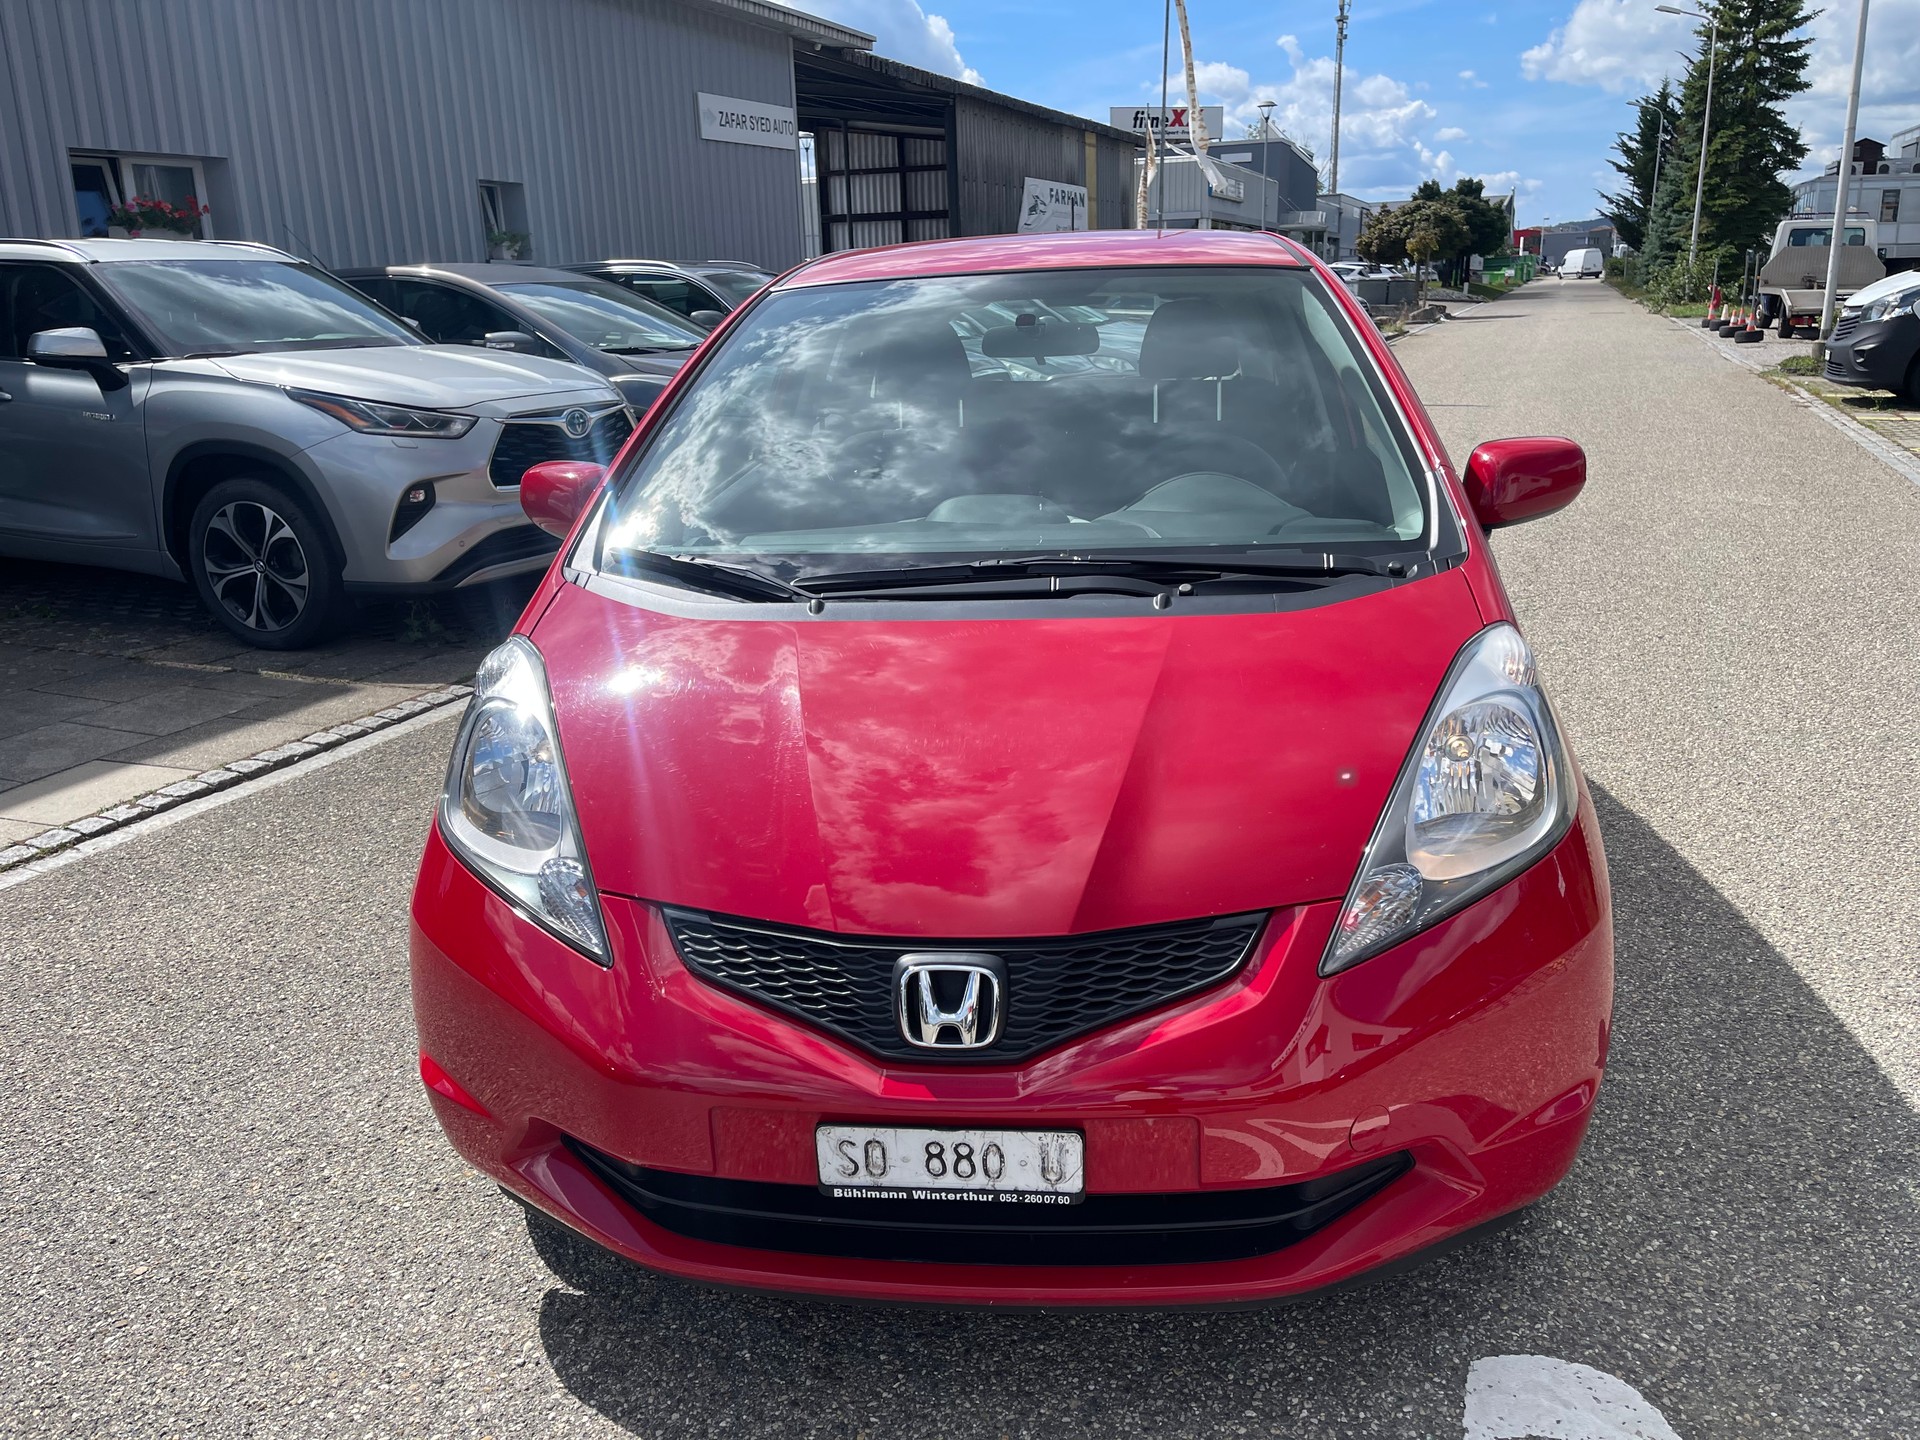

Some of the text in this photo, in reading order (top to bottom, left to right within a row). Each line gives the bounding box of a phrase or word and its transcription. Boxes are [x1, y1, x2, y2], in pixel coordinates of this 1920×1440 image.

[718, 110, 794, 136] ZAFAR SYED AUTO
[924, 1140, 1005, 1180] 880
[1040, 1141, 1065, 1183] U
[833, 1188, 907, 1199] Bühlmann
[912, 1189, 994, 1202] Winterthur
